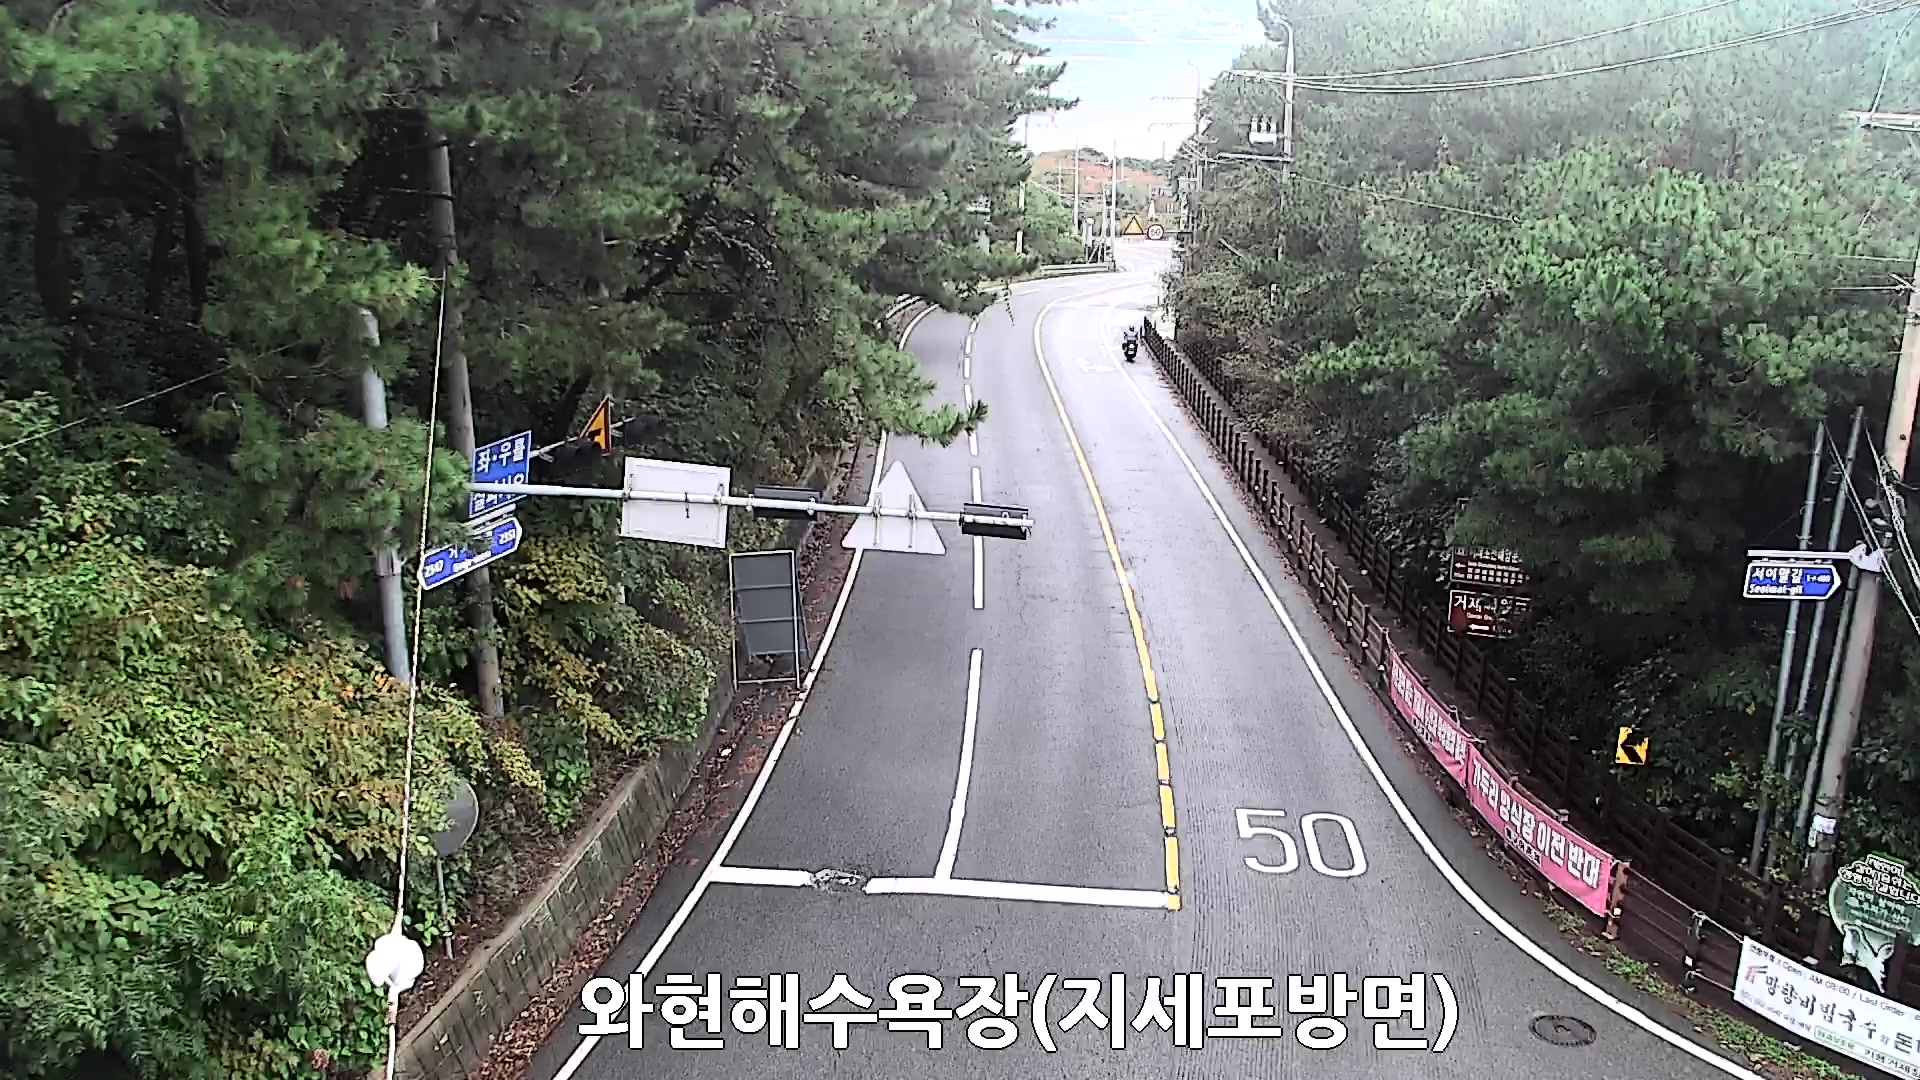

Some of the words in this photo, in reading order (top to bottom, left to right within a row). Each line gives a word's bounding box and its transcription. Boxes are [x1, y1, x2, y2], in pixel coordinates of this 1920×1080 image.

[1751, 567, 1803, 584] 서이말길
[1235, 808, 1368, 878] 50
[1472, 757, 1500, 812] 가두리
[1500, 787, 1536, 843] 양식장
[1537, 820, 1566, 867] 이전
[1567, 840, 1601, 890] 반대
